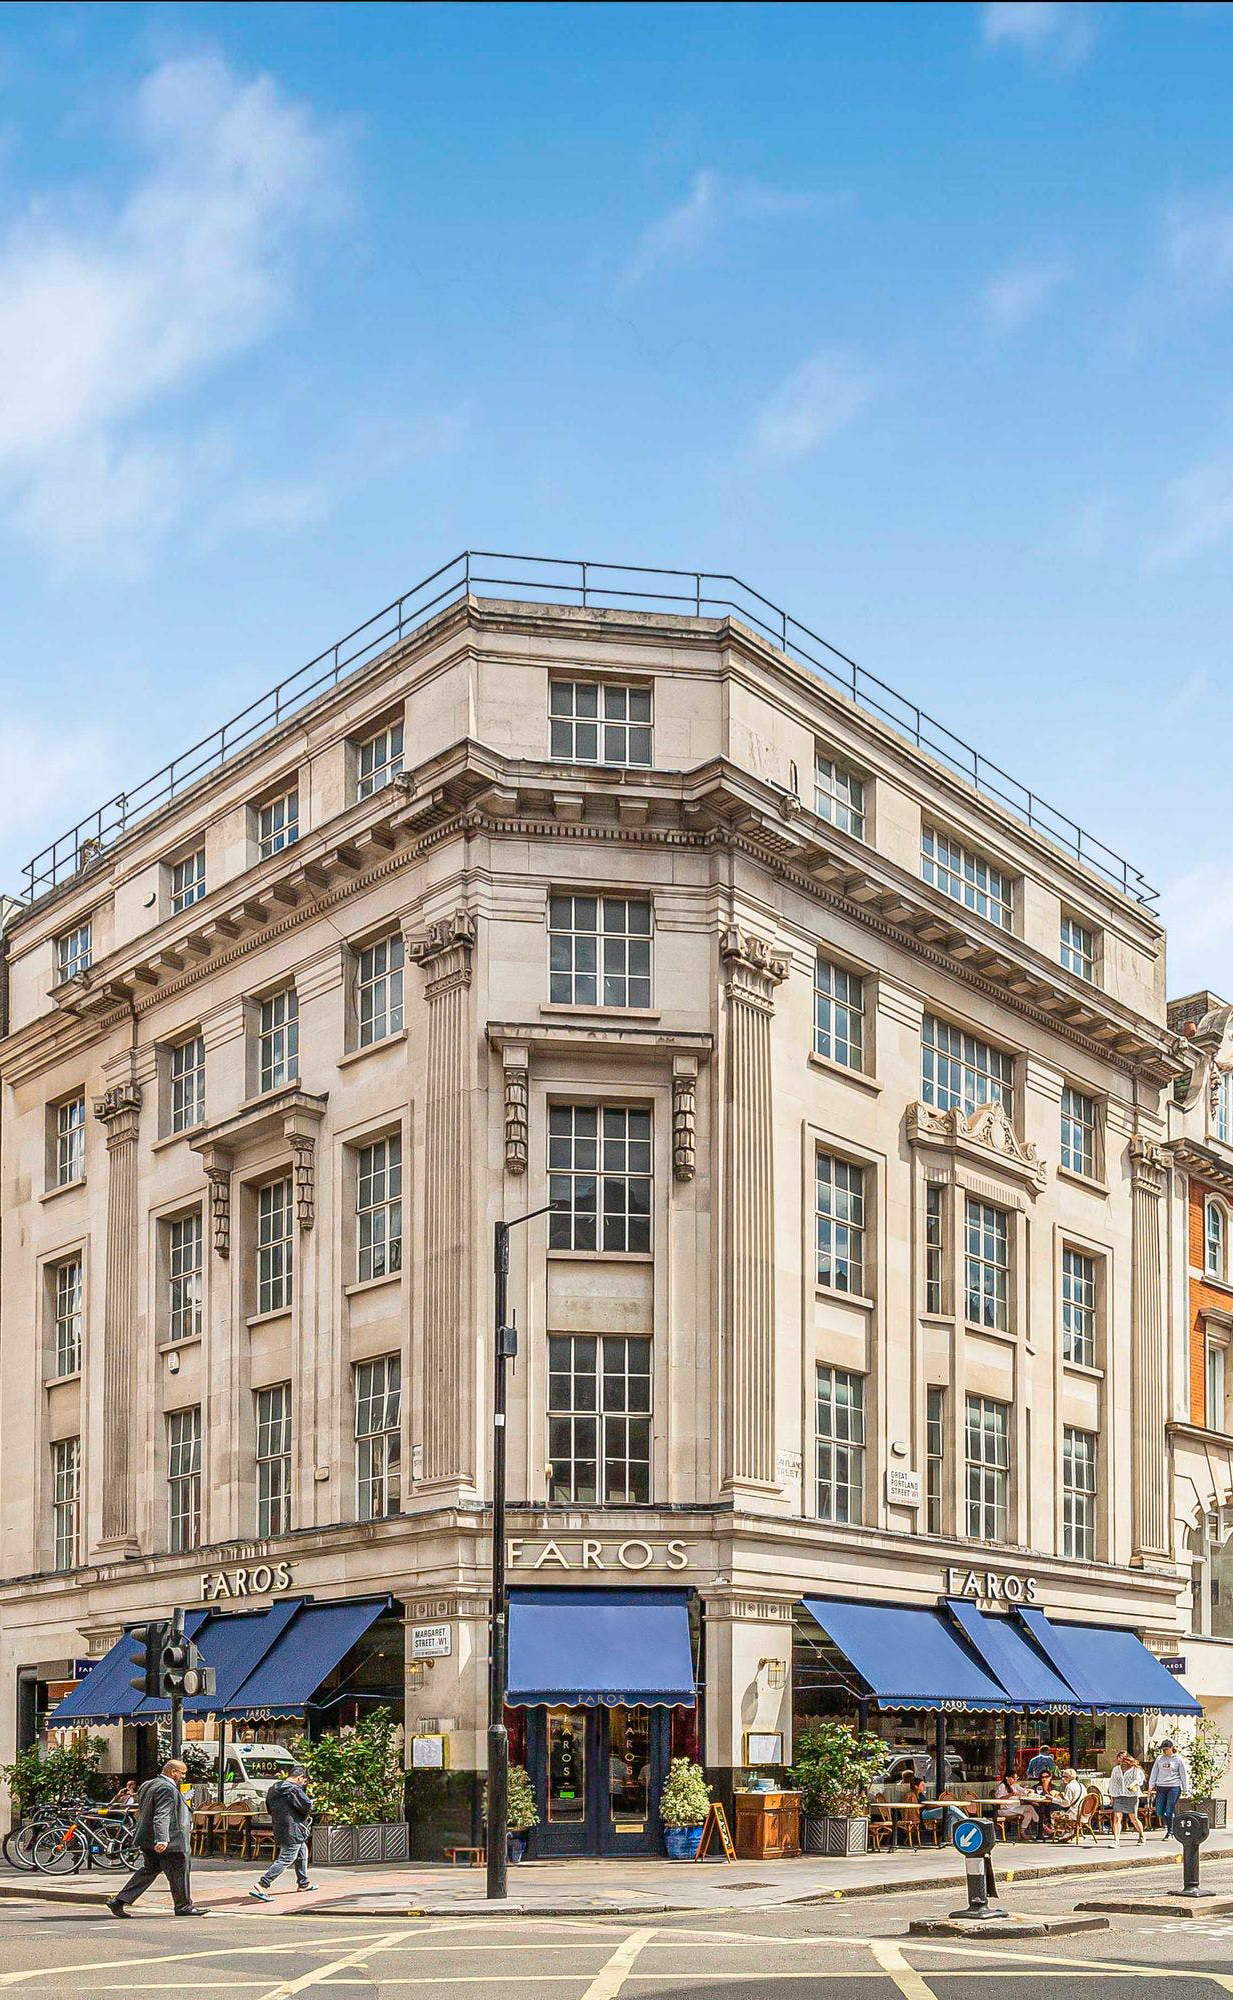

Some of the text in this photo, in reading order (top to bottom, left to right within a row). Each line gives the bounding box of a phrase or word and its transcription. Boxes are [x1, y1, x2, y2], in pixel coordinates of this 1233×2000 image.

[890, 1470, 908, 1480] GREAT
[890, 1478, 919, 1490] PORTLAND
[890, 1487, 919, 1498] STREET W1
[506, 1538, 689, 1570] FAROS
[200, 1561, 290, 1601] FAROS
[948, 1567, 1038, 1604] FAROS
[414, 1627, 446, 1639] MARGARET
[414, 1637, 447, 1648] STREET W1
[578, 1694, 626, 1704] FAROS
[940, 1700, 968, 1709] FAROS
[1049, 1703, 1072, 1712] FAROS
[245, 1708, 271, 1717] FAROS
[1142, 1707, 1162, 1715] FAROS
[73, 1717, 94, 1726] FAROS
[154, 1713, 172, 1722] FARO
[561, 1714, 572, 1776] FAROS
[624, 1713, 635, 1776] FAROS
[252, 1761, 278, 1771] FAROS
